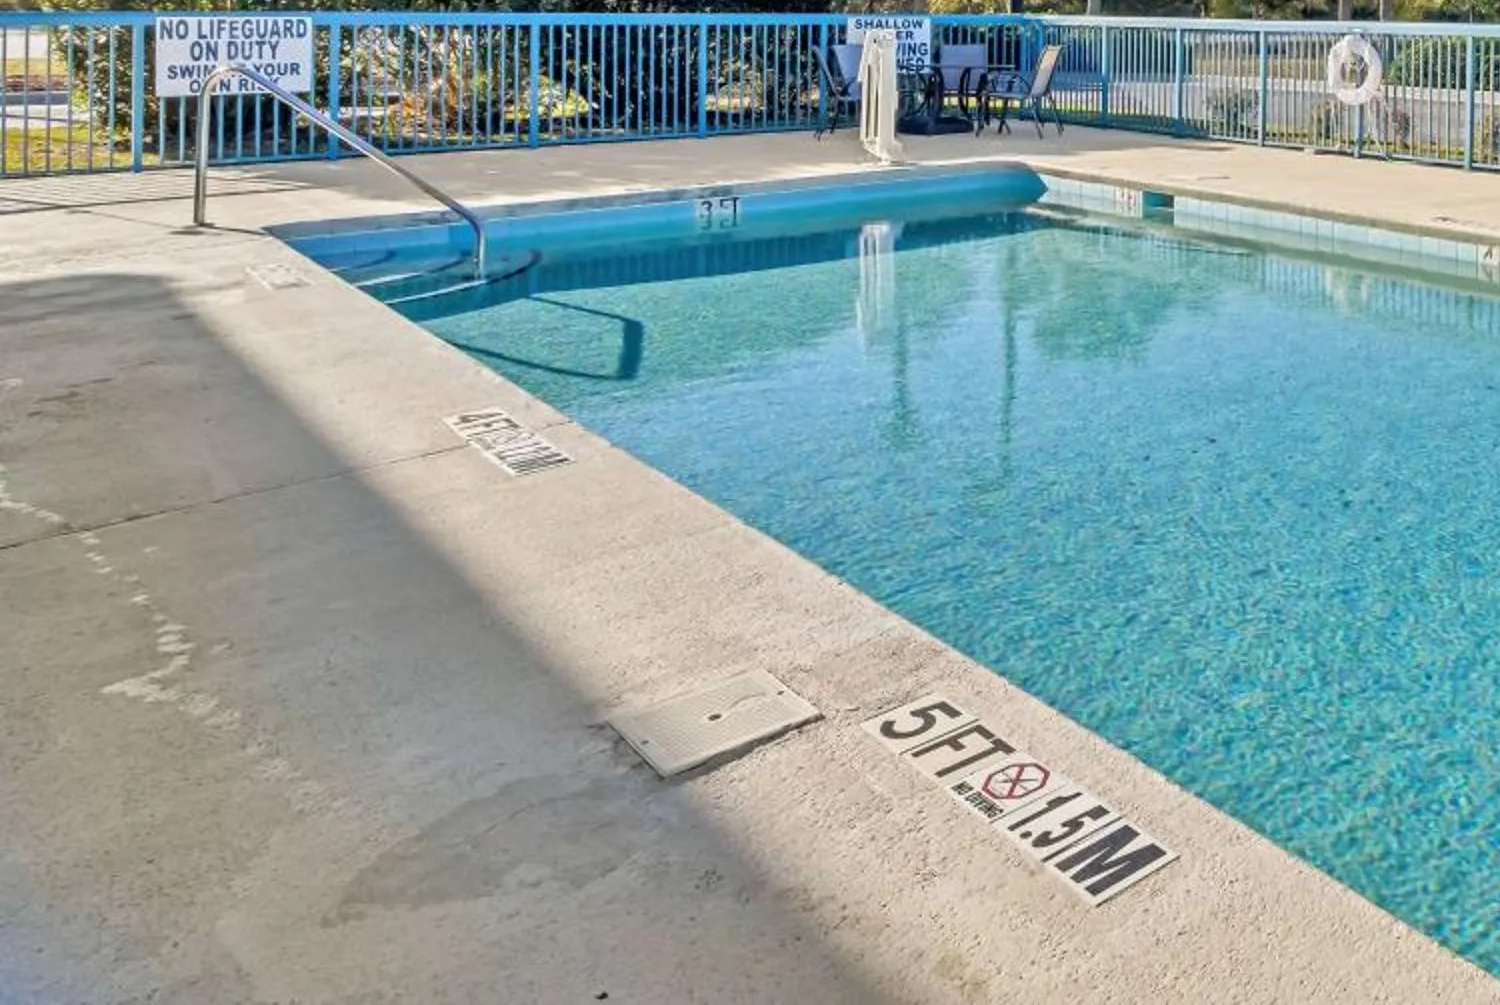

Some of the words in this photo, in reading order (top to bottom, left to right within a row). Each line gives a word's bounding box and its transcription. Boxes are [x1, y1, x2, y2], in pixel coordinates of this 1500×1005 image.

[159, 19, 189, 40] NO
[197, 18, 307, 40] LIFEGUARD
[854, 18, 923, 30] SHALLOW
[189, 41, 219, 62] ON
[227, 40, 280, 60] DUTY
